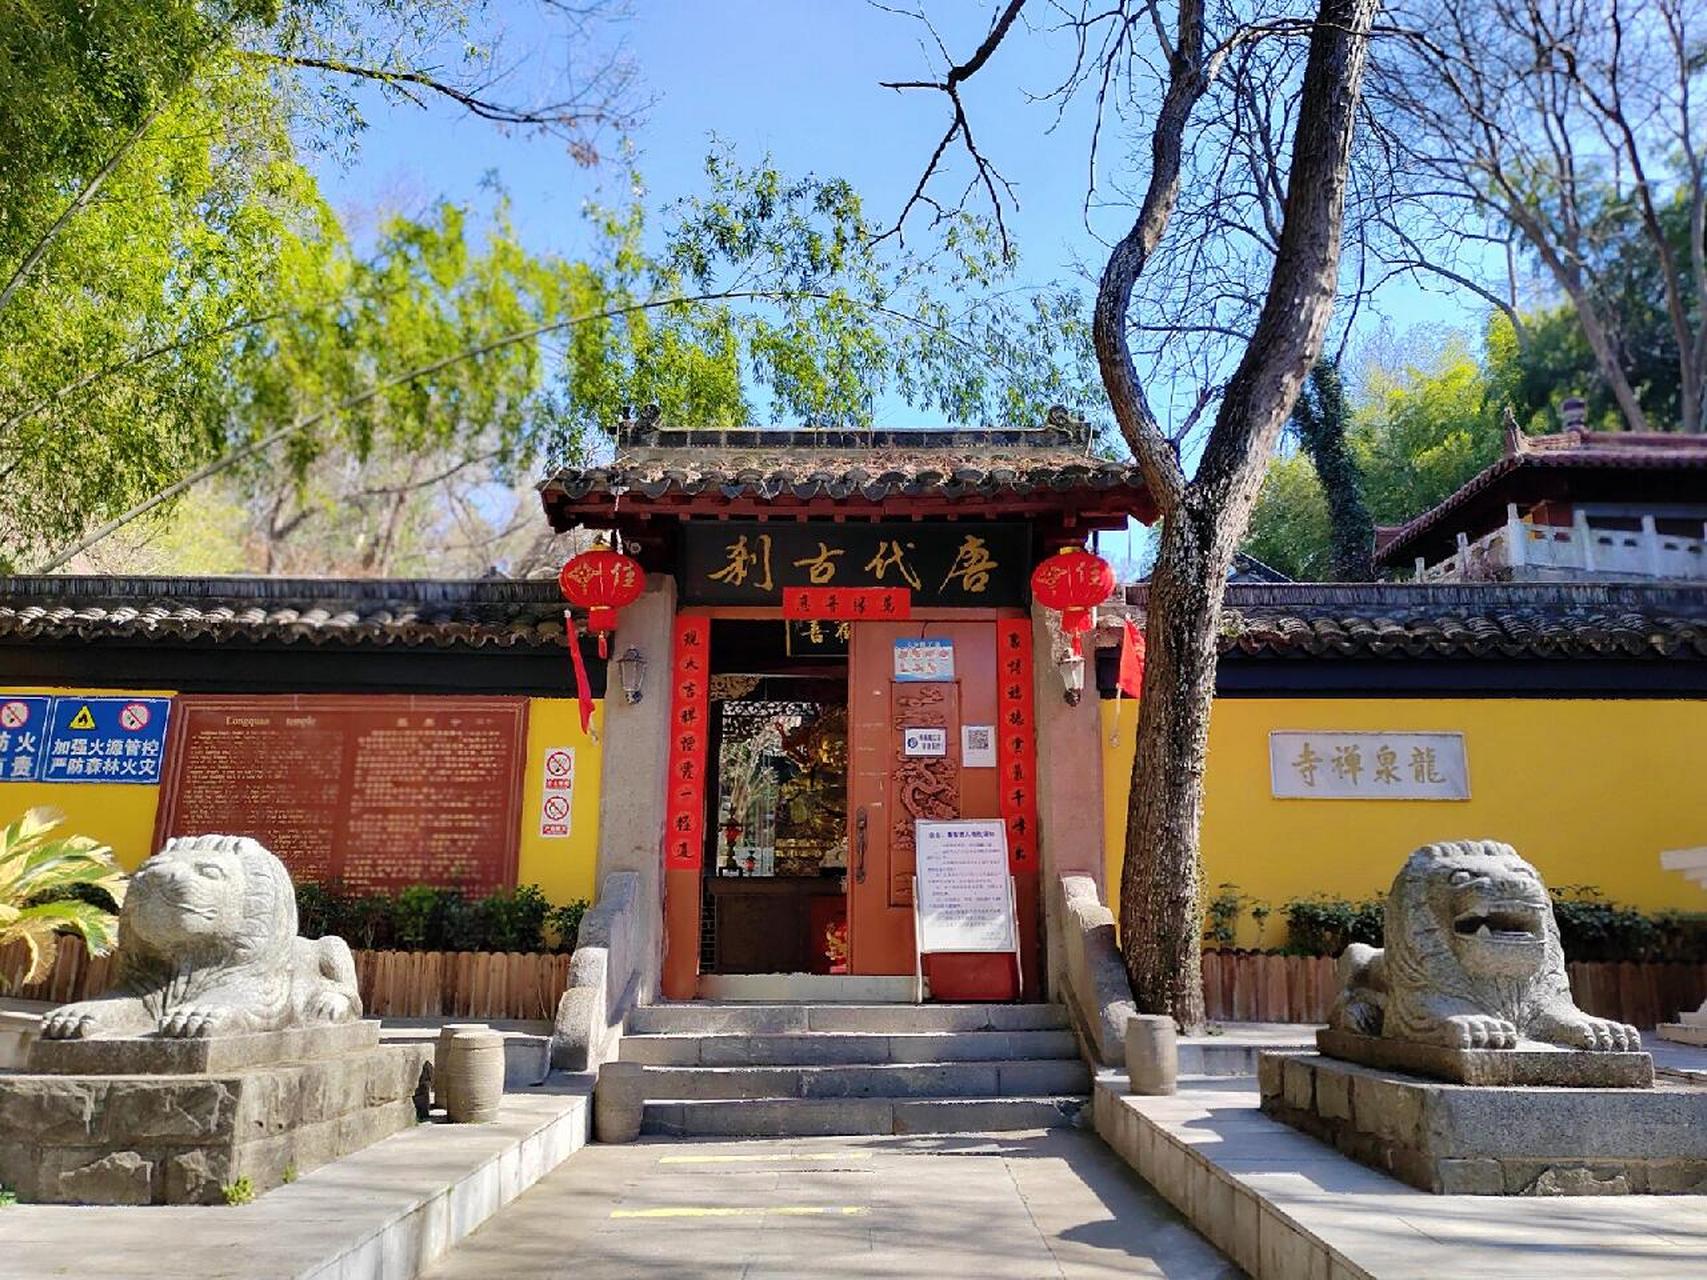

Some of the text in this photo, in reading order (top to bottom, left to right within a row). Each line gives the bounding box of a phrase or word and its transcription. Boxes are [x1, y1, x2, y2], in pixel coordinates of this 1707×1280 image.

[226, 716, 270, 728] Longquan
[51, 738, 160, 757] 加强火源管控
[48, 757, 156, 776] 严防森林火灾
